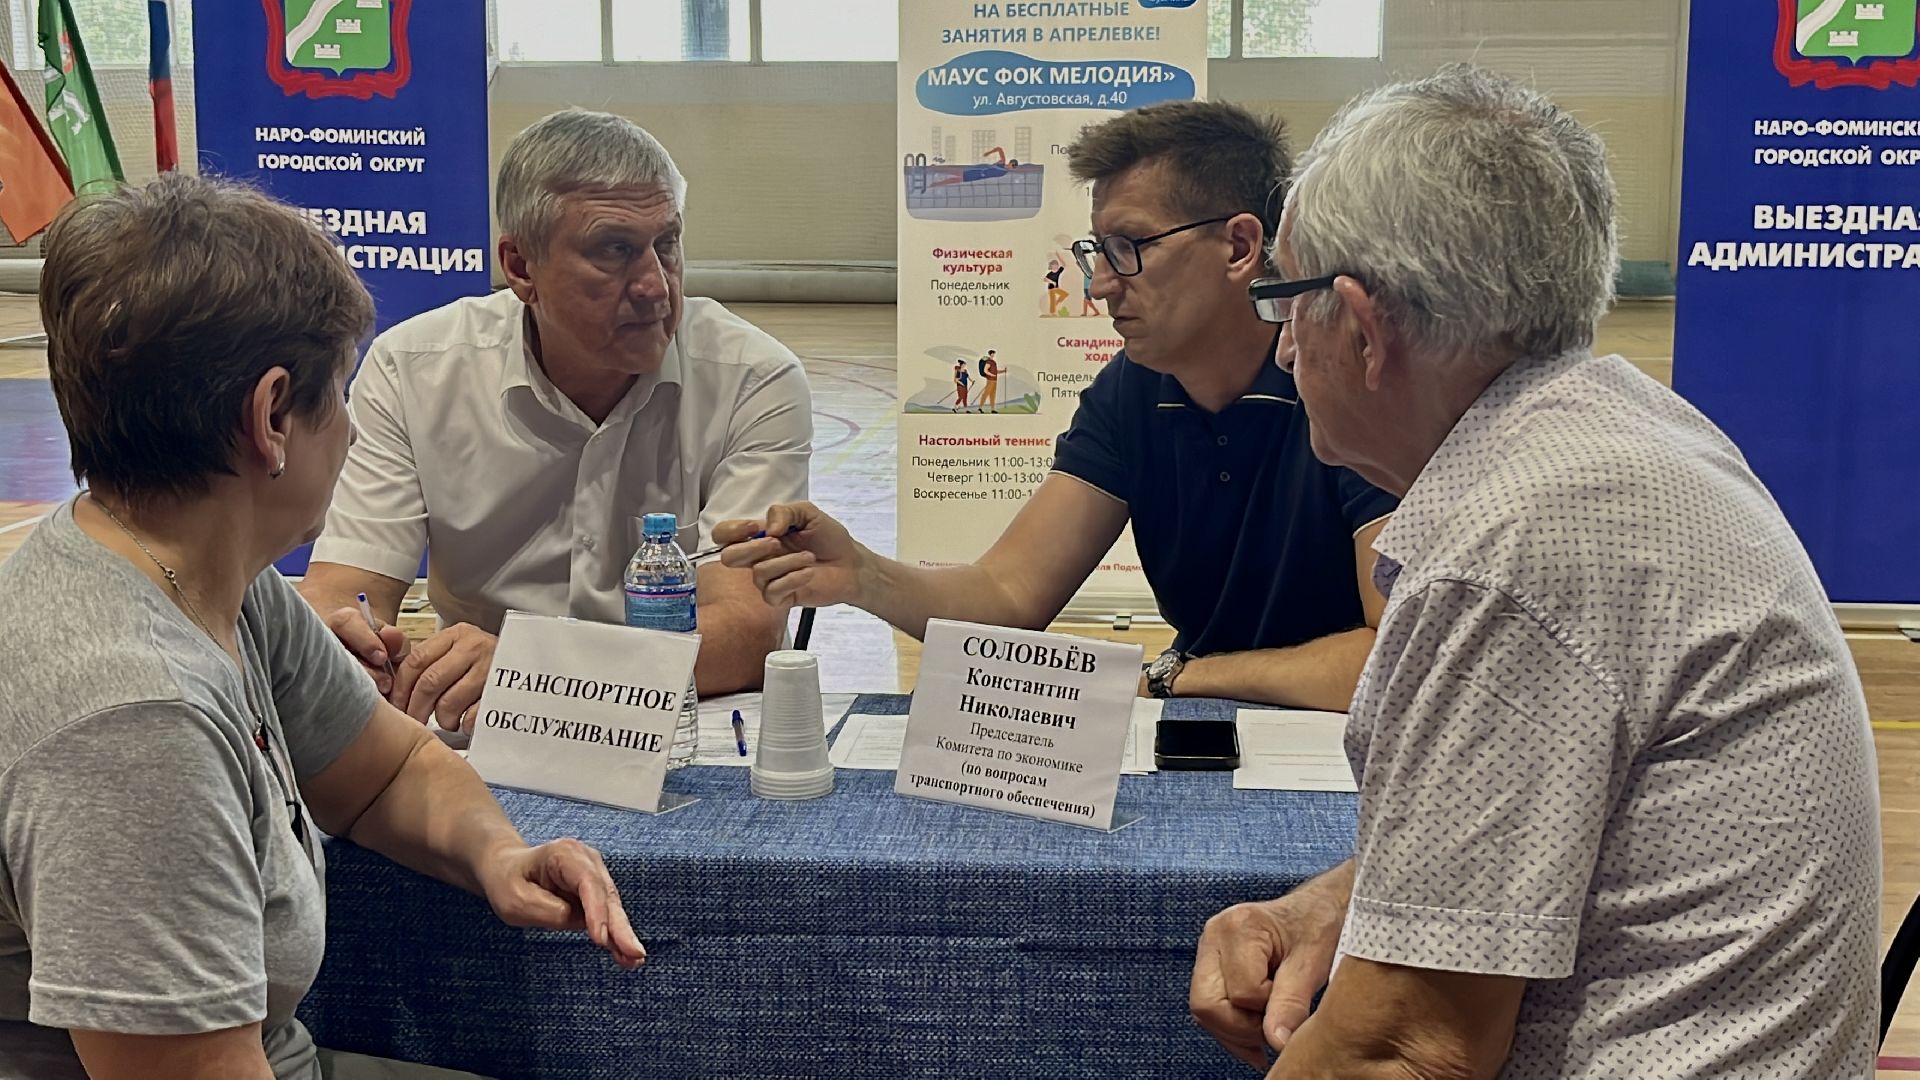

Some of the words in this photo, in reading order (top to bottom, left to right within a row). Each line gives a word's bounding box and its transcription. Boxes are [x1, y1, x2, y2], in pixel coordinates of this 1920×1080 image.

[974, 3, 999, 18] НА
[1006, 2, 1129, 17] БЕСПЛАТНЫЕ
[942, 28, 1026, 44] ЗАНЯТИЯ
[1033, 28, 1043, 42] В
[1050, 26, 1160, 42] АПРЕЛЕВКЕ!
[927, 67, 989, 86] МАУС
[994, 67, 1043, 85] ФОК
[1050, 66, 1175, 87] МЕЛОДИЯ»
[973, 95, 991, 109] ул.
[996, 92, 1094, 107] Августовская,
[1097, 91, 1128, 107] д.40
[255, 127, 426, 146] НАРО-ФОМИНСКИЙ
[258, 153, 362, 172] ГОРОДСКОЙ
[369, 157, 425, 173] ОКРУГ
[1754, 145, 1872, 167] ГОРОДСКОЙ
[1880, 149, 1920, 165] ОКР
[300, 207, 427, 237] ЕЗДНАЯ
[1754, 205, 1920, 235] ВЫЕЗДНА
[337, 245, 484, 275] СТРАЦИЯ
[932, 248, 1013, 259] Физическая
[1687, 242, 1920, 271] АДМИНИСТРА
[943, 264, 1003, 275] культура
[930, 279, 1010, 291] Понедельник
[937, 295, 1004, 306] 10:00-11:00
[1057, 336, 1124, 350] Скандина
[1084, 353, 1113, 363] ход
[1037, 371, 1096, 384] Понедель
[1051, 387, 1080, 398] Пятн
[919, 434, 1001, 447] Настольный
[1005, 437, 1051, 446] теннис
[912, 456, 990, 469] Понедельник
[994, 457, 1054, 467] 11:00-13:0
[927, 472, 974, 485] Четверг
[978, 472, 1043, 483] 11:00-13:00
[913, 488, 987, 501] Воскресенье
[991, 489, 1033, 499] 11:00-1
[963, 636, 1097, 674] СОЛОВЬЁВ
[495, 668, 677, 712] ТРАНСПОРТНОЕ
[966, 667, 1081, 701] Константин
[959, 694, 1076, 729] Николаевич
[485, 709, 663, 753] ОБСЛУЖИВАНИЕ
[970, 722, 1055, 748] Председатель
[936, 736, 994, 758] Комитета
[997, 749, 1013, 761] по
[1015, 753, 1083, 773] экономике
[961, 761, 982, 776] (по
[985, 767, 1048, 788] вопросам
[910, 774, 1004, 800] транспортного
[1007, 790, 1096, 818] обеспечения)
